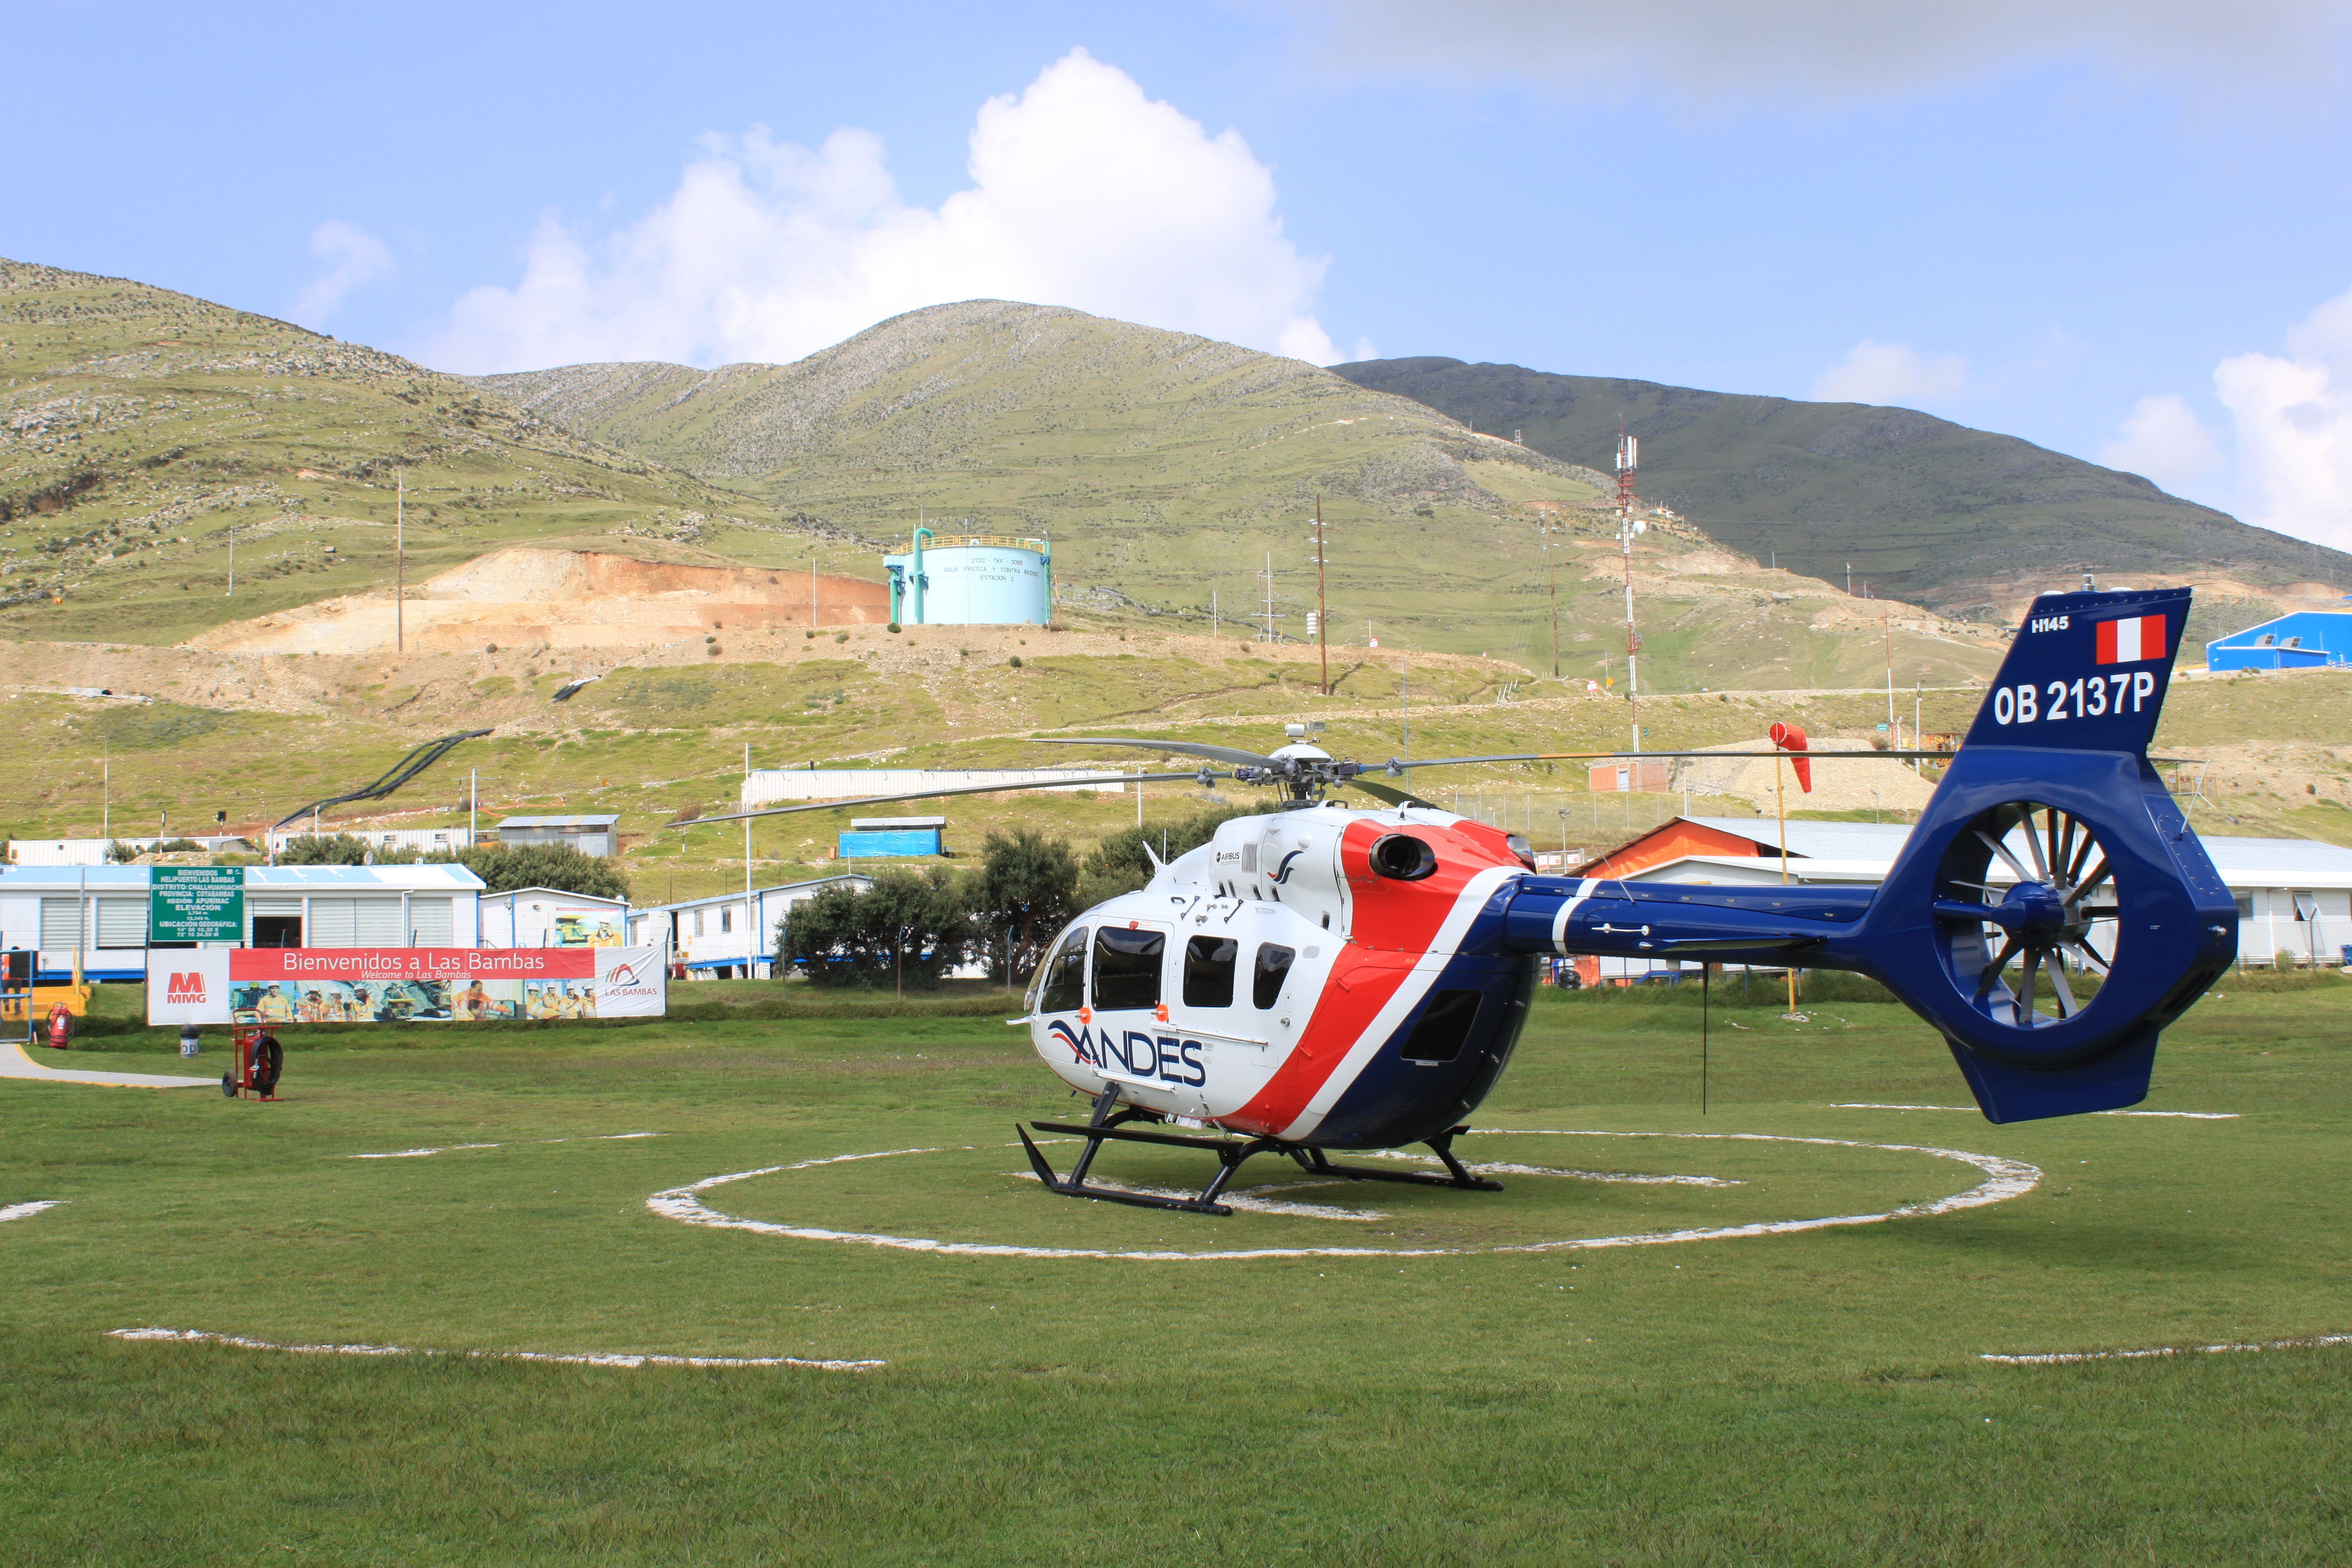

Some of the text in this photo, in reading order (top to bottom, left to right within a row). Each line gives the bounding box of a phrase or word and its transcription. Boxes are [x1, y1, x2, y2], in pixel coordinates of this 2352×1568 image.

[2031, 616, 2069, 633] H145
[1994, 672, 2156, 725] OB 2137P
[1221, 852, 1240, 860] AIRBUS
[284, 952, 545, 970] Bienvenidos a Las Bambas
[435, 970, 471, 979] Bambas
[167, 994, 207, 1004] MMG
[1075, 1025, 1206, 1087] ANDES
